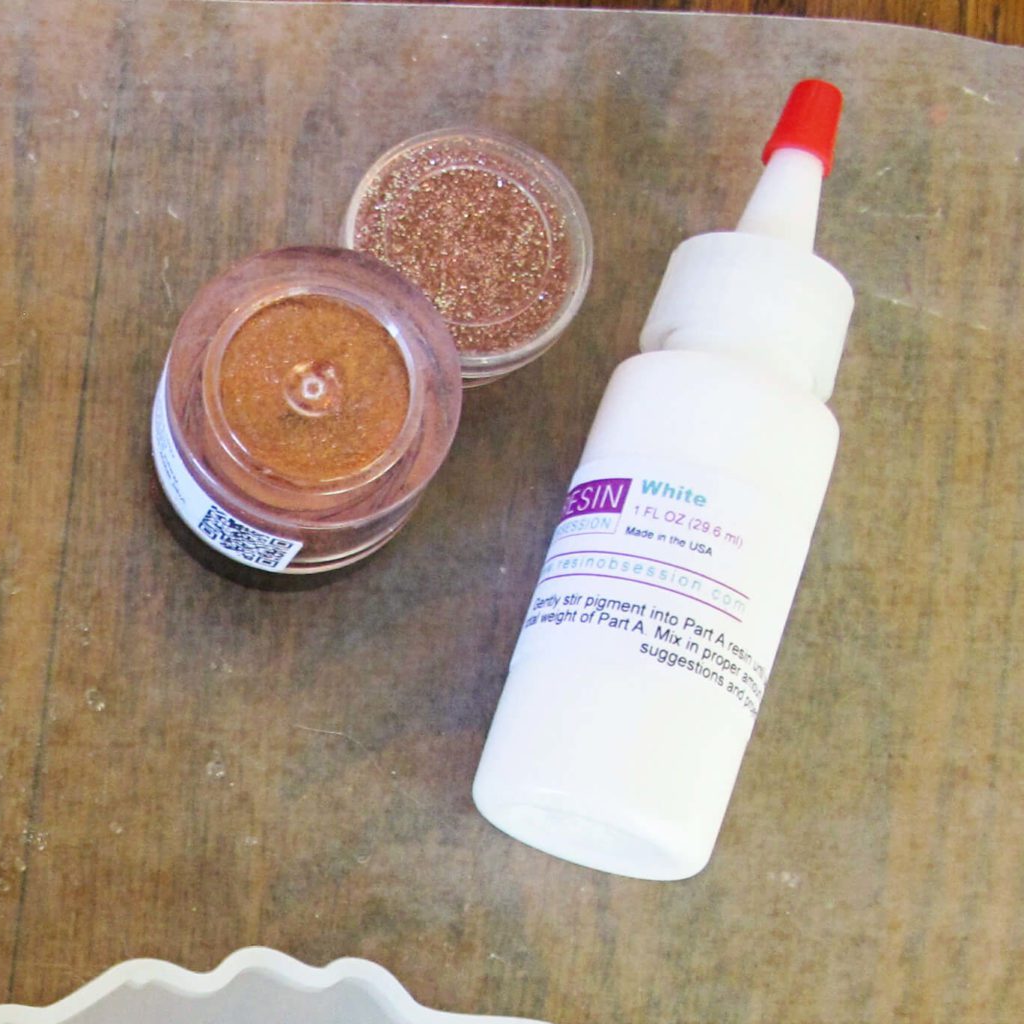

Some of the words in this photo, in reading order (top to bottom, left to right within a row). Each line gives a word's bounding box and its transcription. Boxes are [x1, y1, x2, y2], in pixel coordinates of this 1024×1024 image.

[642, 478, 708, 508] White
[625, 526, 656, 540] Made
[657, 531, 667, 542] in
[669, 535, 687, 549] the
[688, 540, 714, 557] USA
[634, 504, 640, 516] 1
[643, 506, 660, 521] FL
[664, 510, 687, 526] OZ
[723, 531, 745, 551] ml)
[540, 609, 578, 626] weight
[580, 610, 597, 625] of
[598, 611, 630, 632] Part
[653, 625, 683, 647] Mix
[685, 637, 700, 654] in
[701, 646, 742, 676] proper
[562, 593, 582, 607] stir
[584, 594, 647, 617] pigment
[649, 605, 679, 627] into
[683, 617, 715, 641] Part
[714, 633, 726, 647] A
[727, 640, 754, 663] resin
[639, 641, 725, 688] suggestions
[726, 680, 745, 702] and
